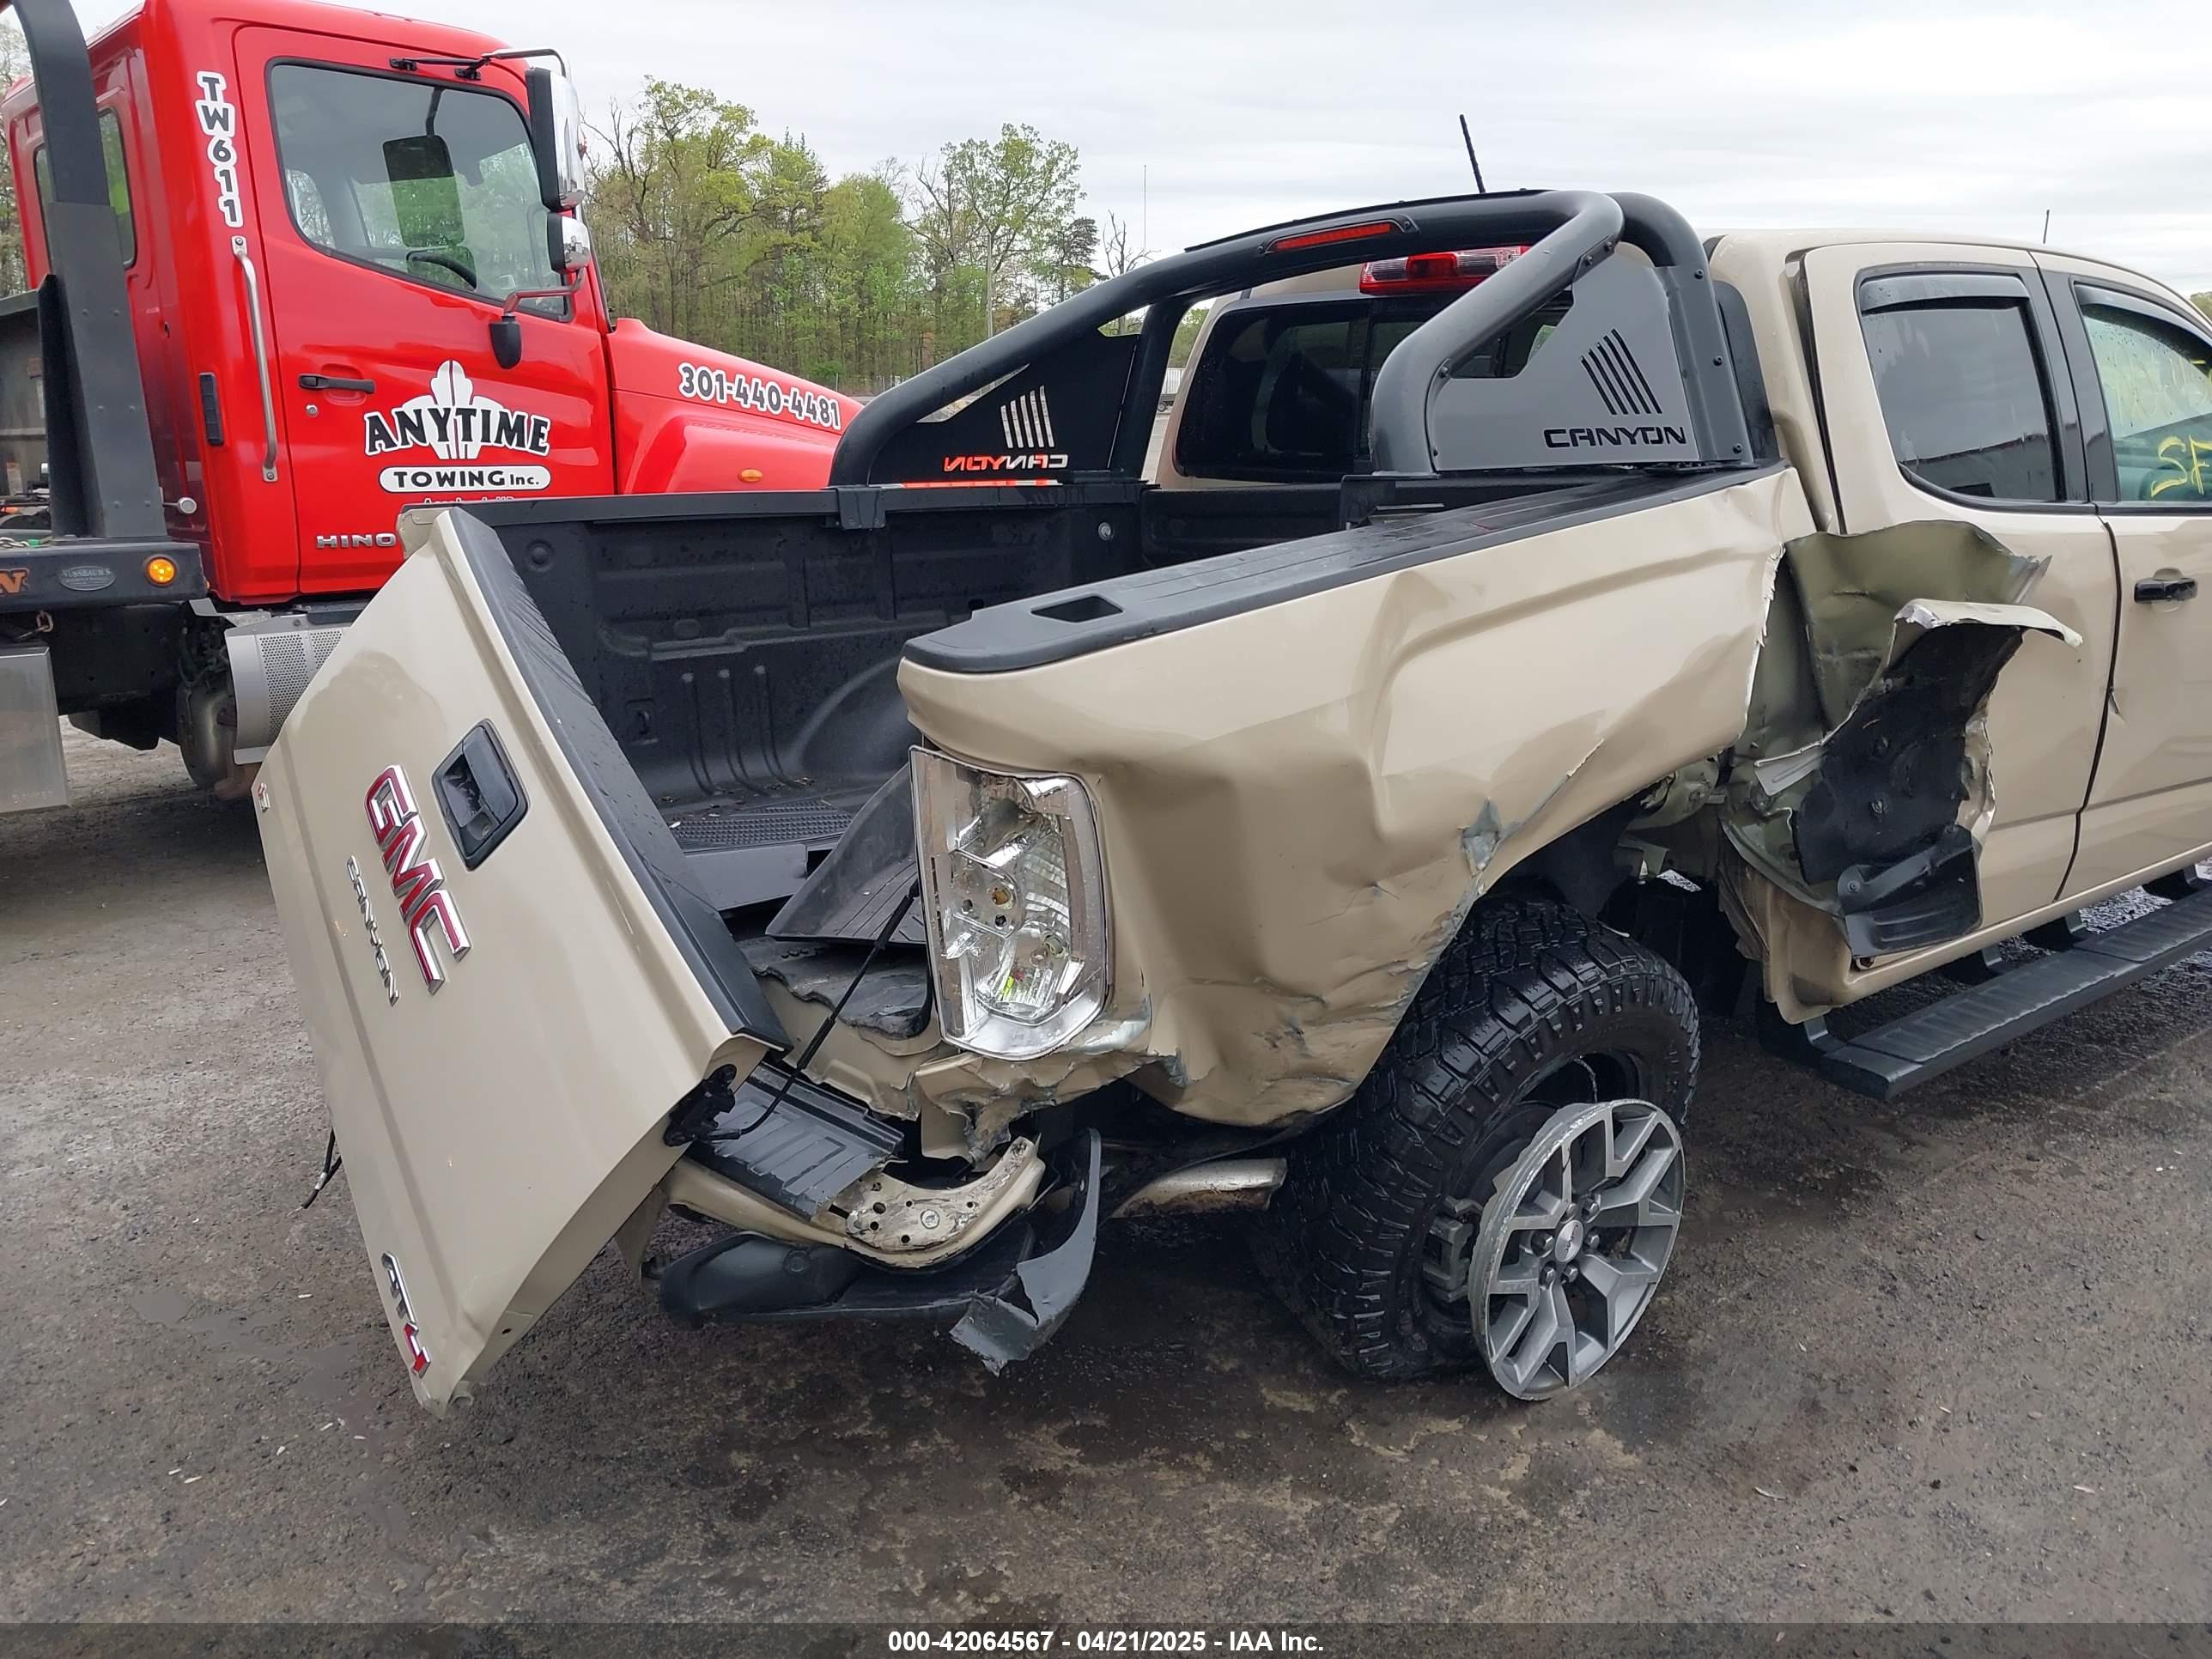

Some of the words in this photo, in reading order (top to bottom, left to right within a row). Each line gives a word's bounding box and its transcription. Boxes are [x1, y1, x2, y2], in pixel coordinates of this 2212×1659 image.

[199, 74, 239, 224] TW611
[680, 364, 841, 428] 301-440-4481
[365, 407, 550, 454] ANYTIME
[1543, 426, 1687, 448] CANYON
[392, 470, 506, 489] TOWING
[509, 473, 540, 486] Inc.
[316, 532, 397, 550] HINO
[364, 764, 471, 997] GMC
[346, 854, 400, 1007] CANYON
